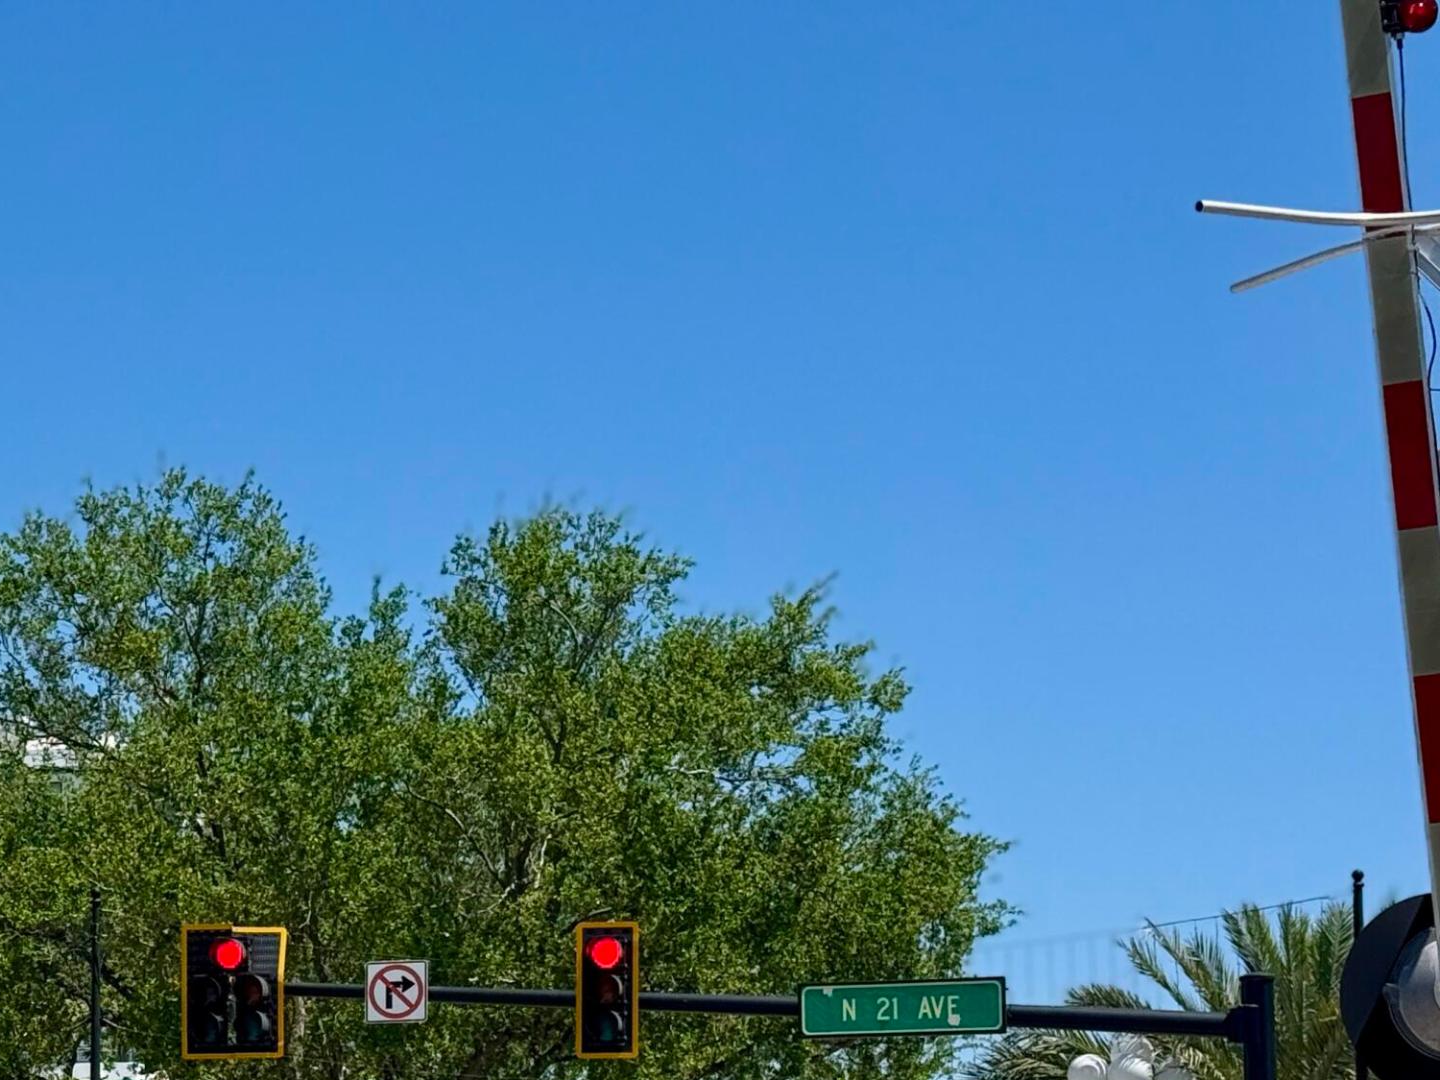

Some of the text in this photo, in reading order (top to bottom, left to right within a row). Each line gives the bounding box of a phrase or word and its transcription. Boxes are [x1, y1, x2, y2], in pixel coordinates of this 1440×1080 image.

[842, 995, 960, 1022] N 21 AVE
